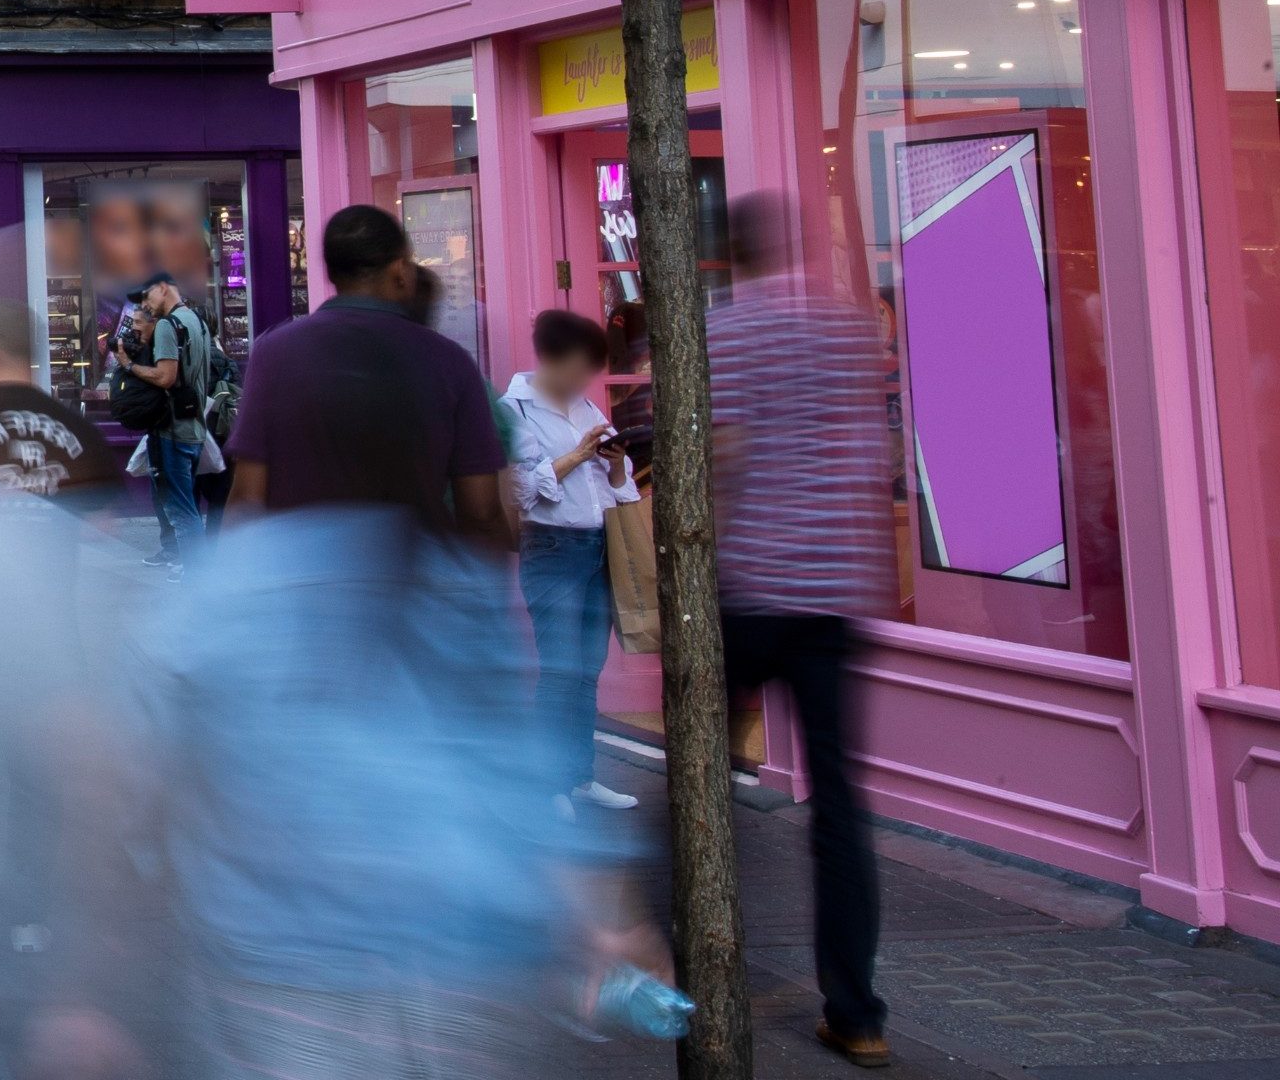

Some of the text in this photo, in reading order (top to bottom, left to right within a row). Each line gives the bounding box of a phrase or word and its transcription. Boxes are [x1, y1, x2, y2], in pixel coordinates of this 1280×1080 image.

[563, 42, 608, 103] Laughter
[610, 50, 623, 76] is
[420, 230, 439, 245] WAX
